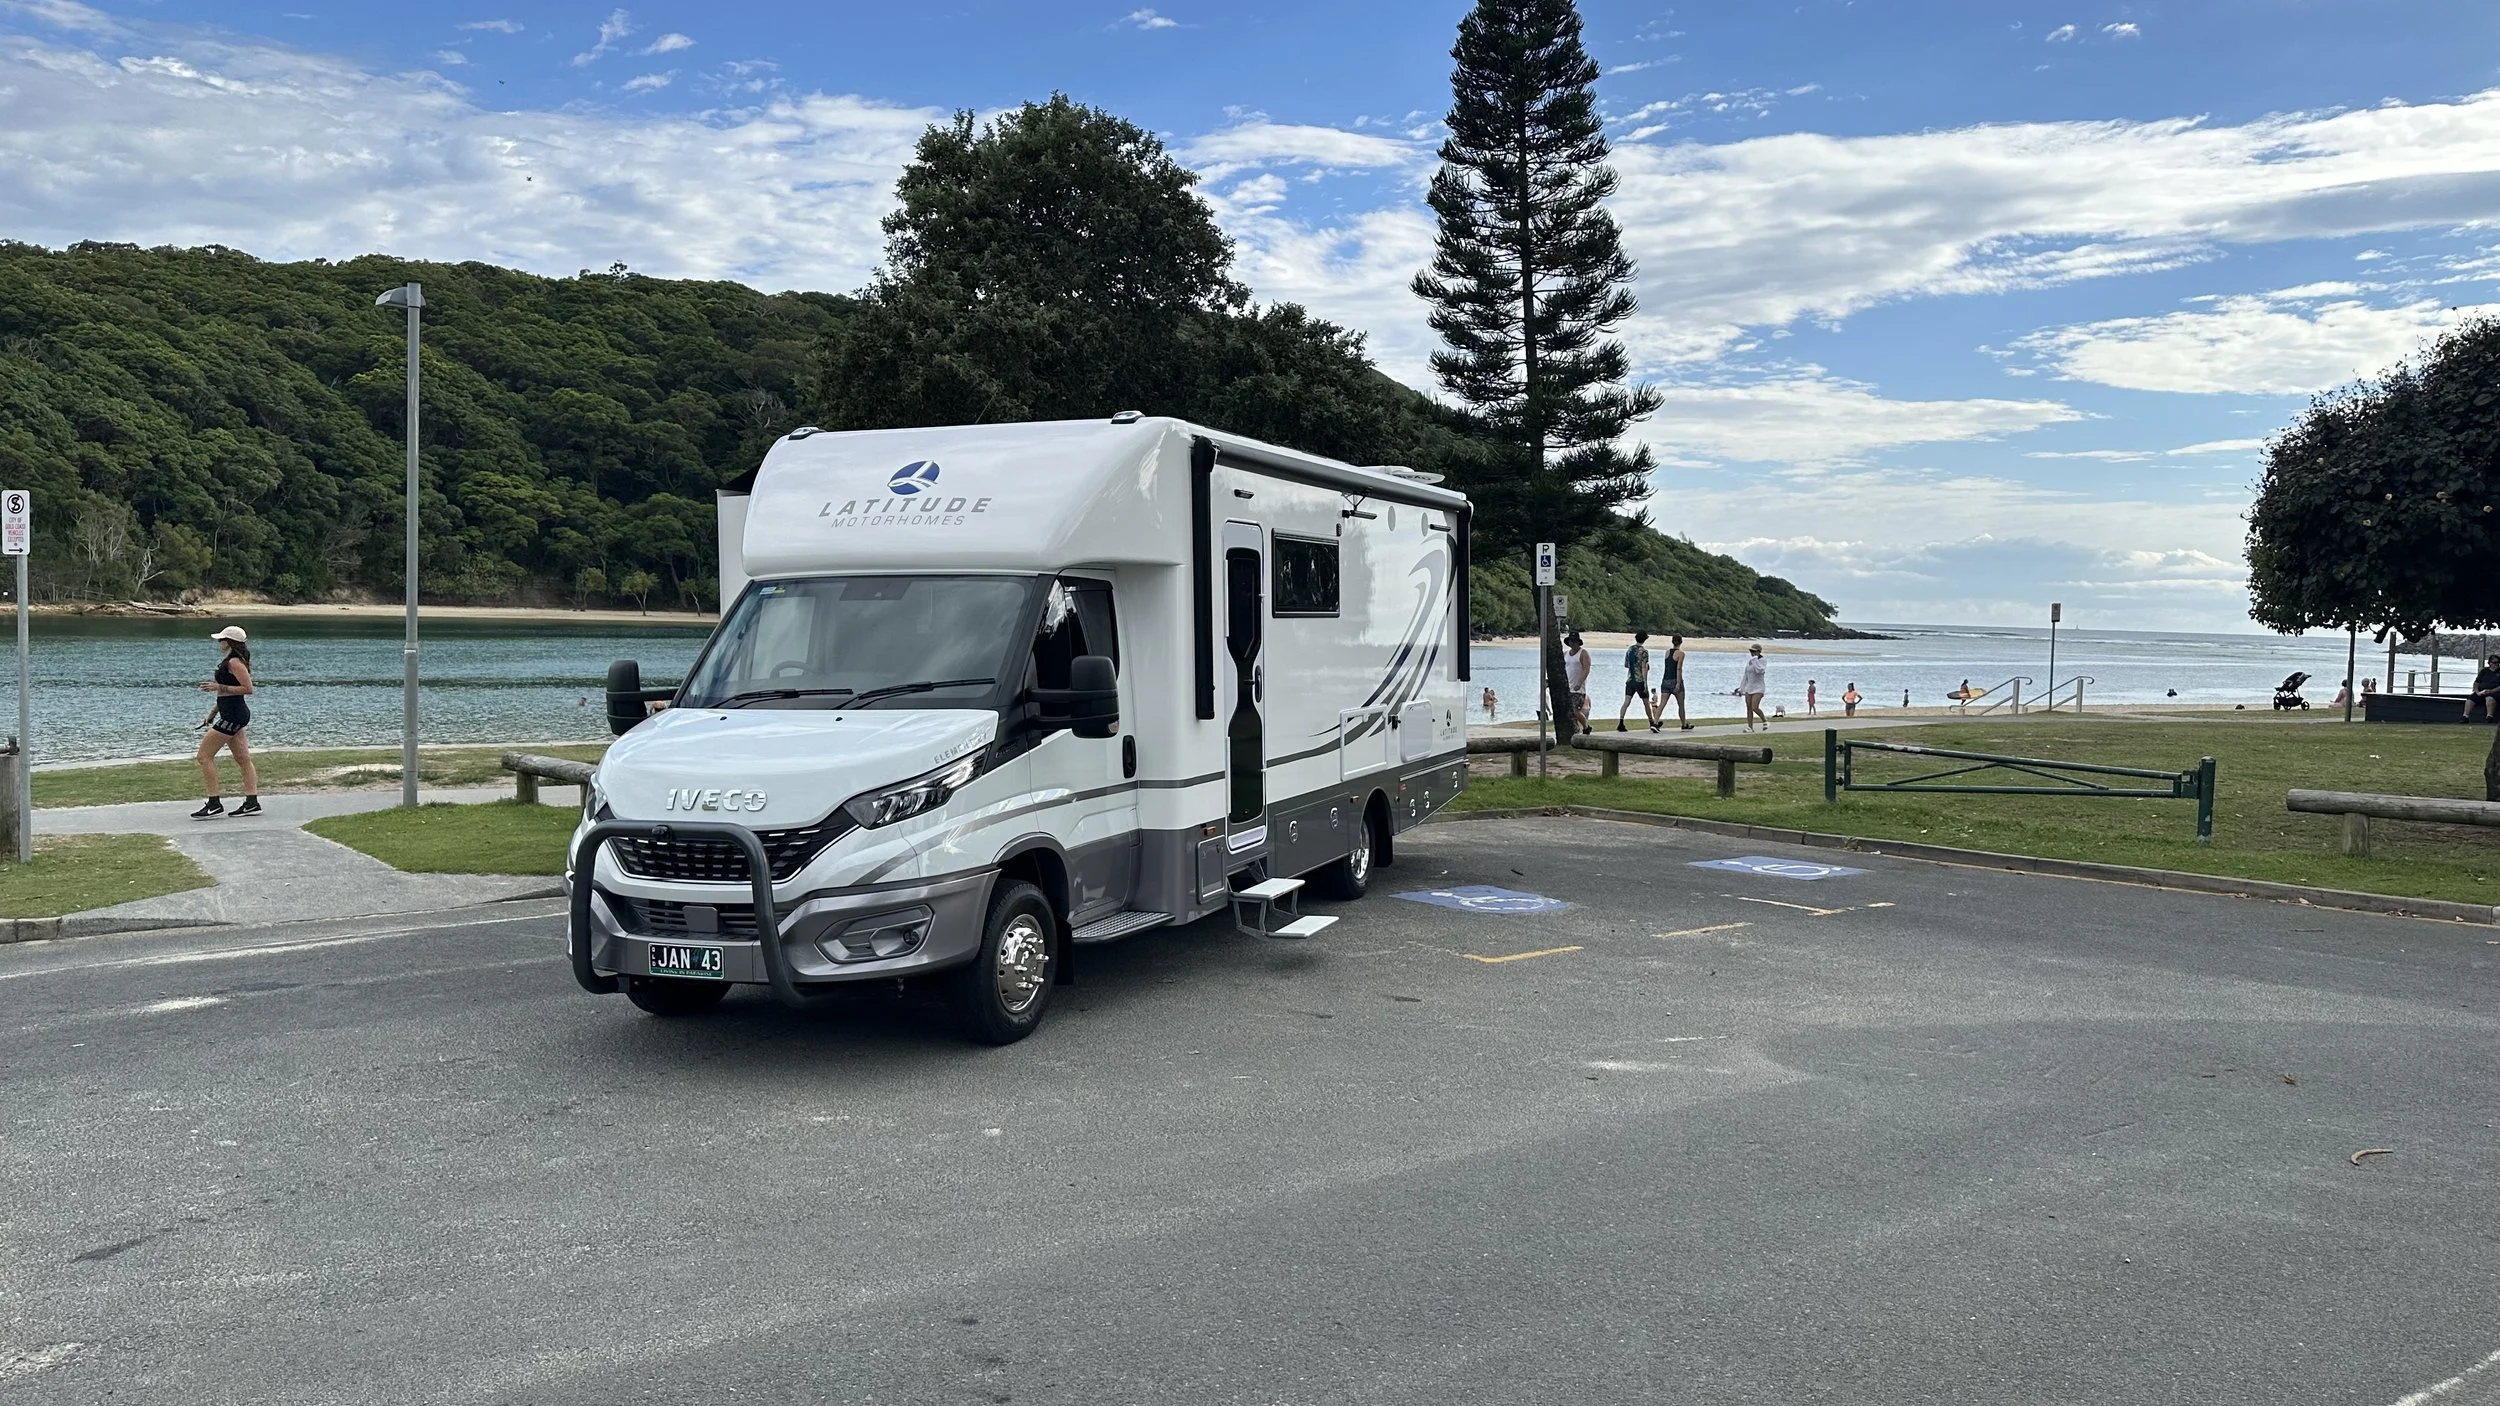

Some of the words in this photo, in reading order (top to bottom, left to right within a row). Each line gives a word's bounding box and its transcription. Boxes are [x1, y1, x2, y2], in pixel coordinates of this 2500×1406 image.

[818, 497, 993, 517] LATITUDE
[831, 515, 966, 528] MOTORHOMES
[1542, 544, 1550, 554] P
[666, 788, 768, 812] IVECO
[658, 947, 691, 969] JAN
[701, 949, 721, 971] 43
